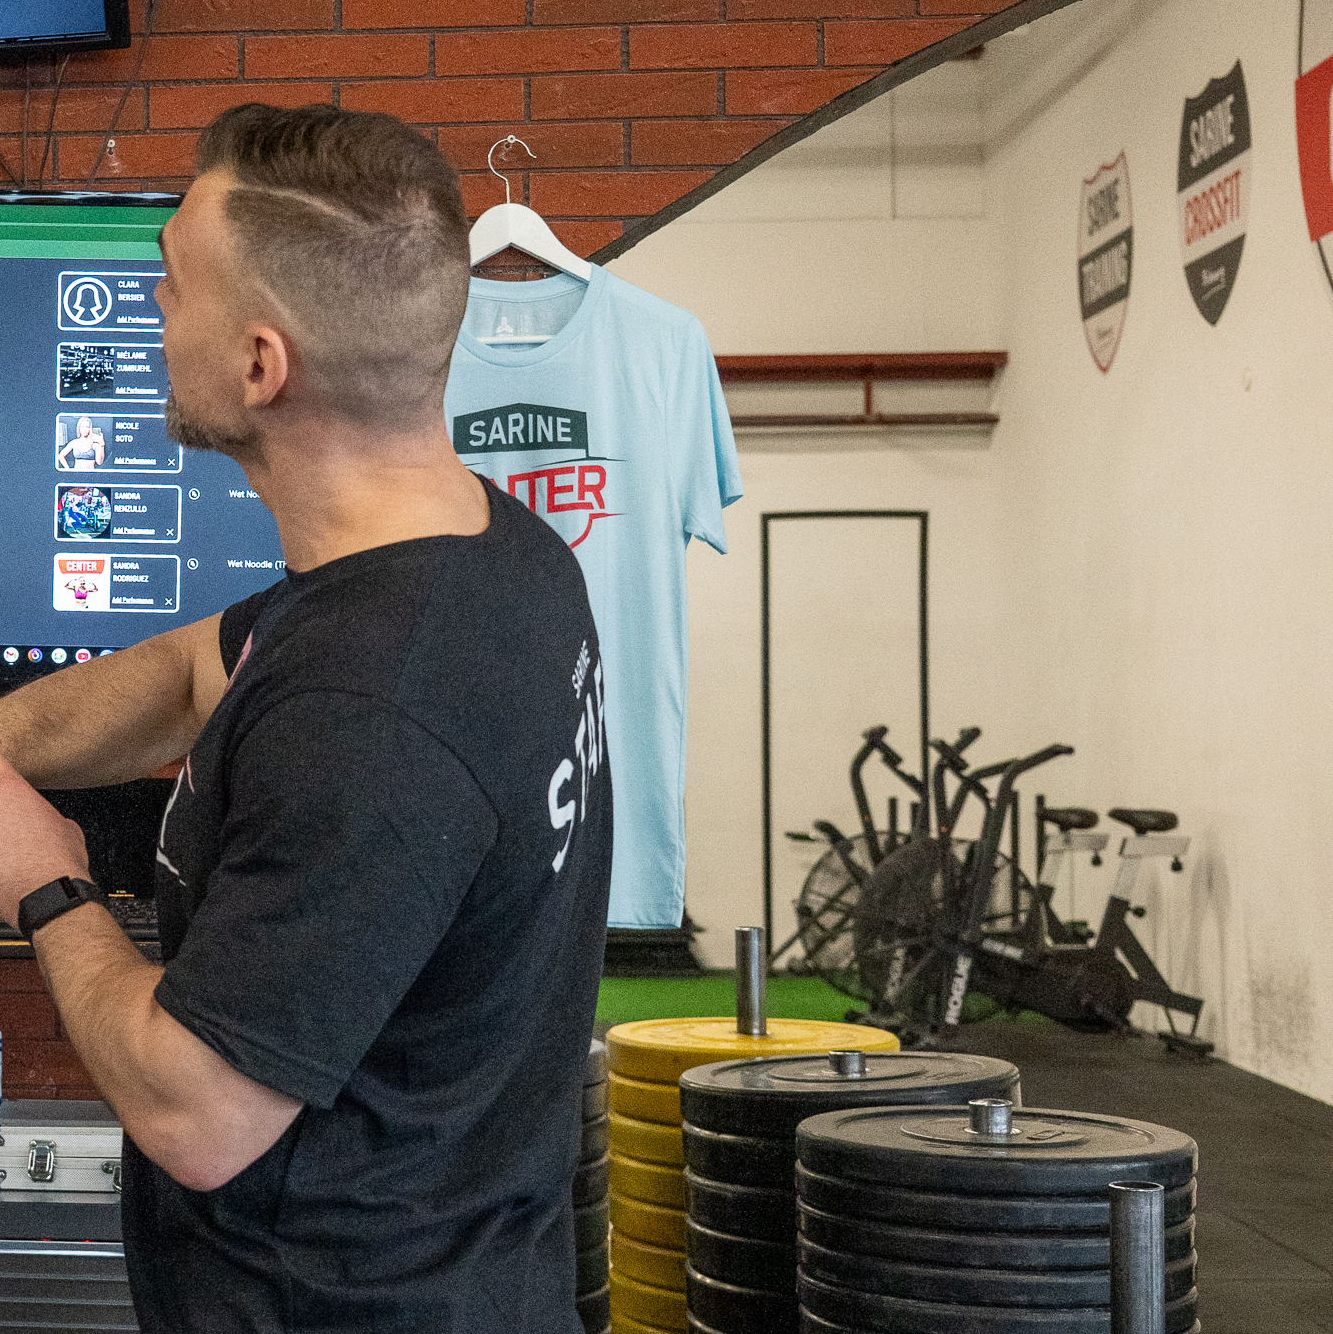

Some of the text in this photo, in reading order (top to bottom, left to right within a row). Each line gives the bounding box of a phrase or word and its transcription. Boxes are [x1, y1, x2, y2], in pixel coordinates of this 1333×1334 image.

[116, 422, 139, 430] NICOLE
[468, 412, 573, 448] SARINE
[229, 490, 244, 498] Wet
[491, 465, 607, 515] TER
[114, 492, 141, 500] SANDRA
[66, 561, 97, 571] CENTER
[113, 561, 139, 570] SANDRA
[228, 560, 273, 568] Wet Noodle
